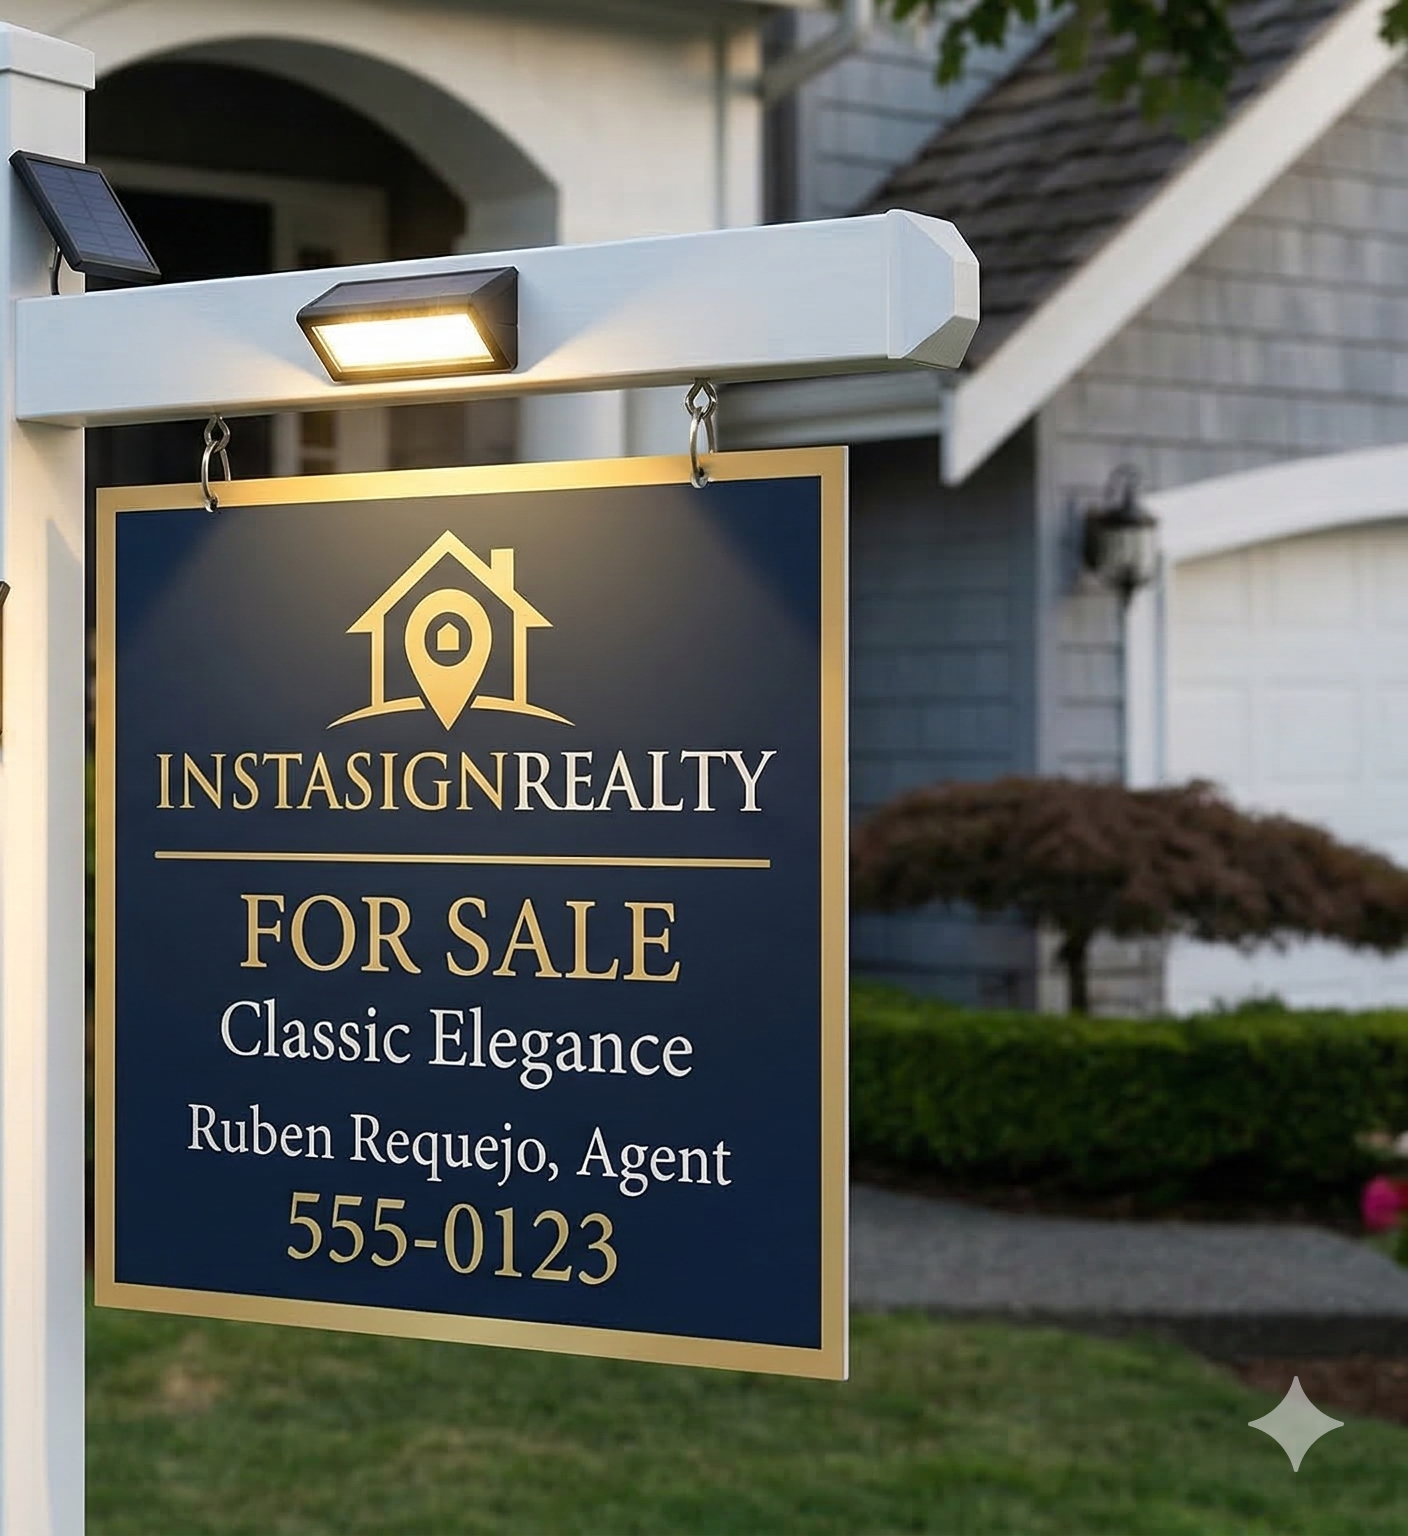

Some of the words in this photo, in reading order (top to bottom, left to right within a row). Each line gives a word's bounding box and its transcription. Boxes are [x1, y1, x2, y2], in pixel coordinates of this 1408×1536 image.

[155, 749, 779, 812] INSTASIGNREALTY
[239, 893, 422, 974] FOR
[445, 895, 682, 983] SALE
[219, 998, 412, 1065] Classic
[428, 1006, 694, 1091] Elegance
[187, 1102, 335, 1159] Ruben
[349, 1112, 559, 1188] Requejo,
[575, 1125, 733, 1198] Agent
[286, 1190, 619, 1287] 555-0123
